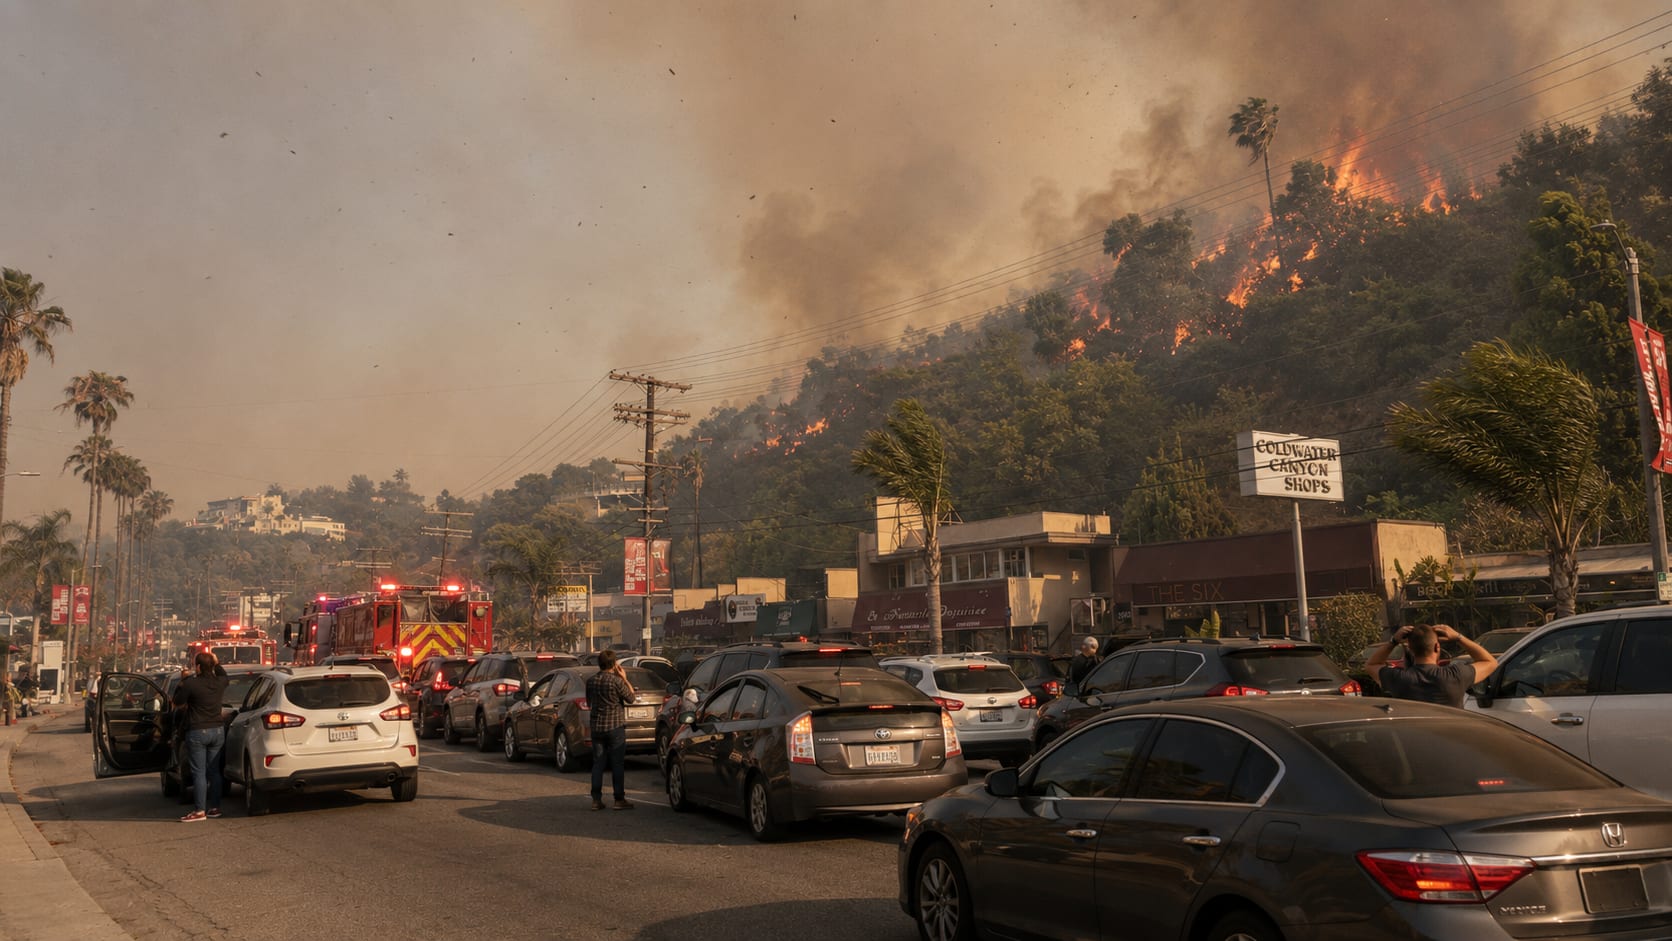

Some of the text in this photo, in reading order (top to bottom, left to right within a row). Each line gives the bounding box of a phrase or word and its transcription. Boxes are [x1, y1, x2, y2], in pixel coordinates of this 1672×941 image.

[1256, 439, 1337, 461] COLDWATER
[1269, 458, 1329, 477] CANYON
[1284, 477, 1331, 494] SHOPS
[1147, 582, 1225, 603] THE SIX
